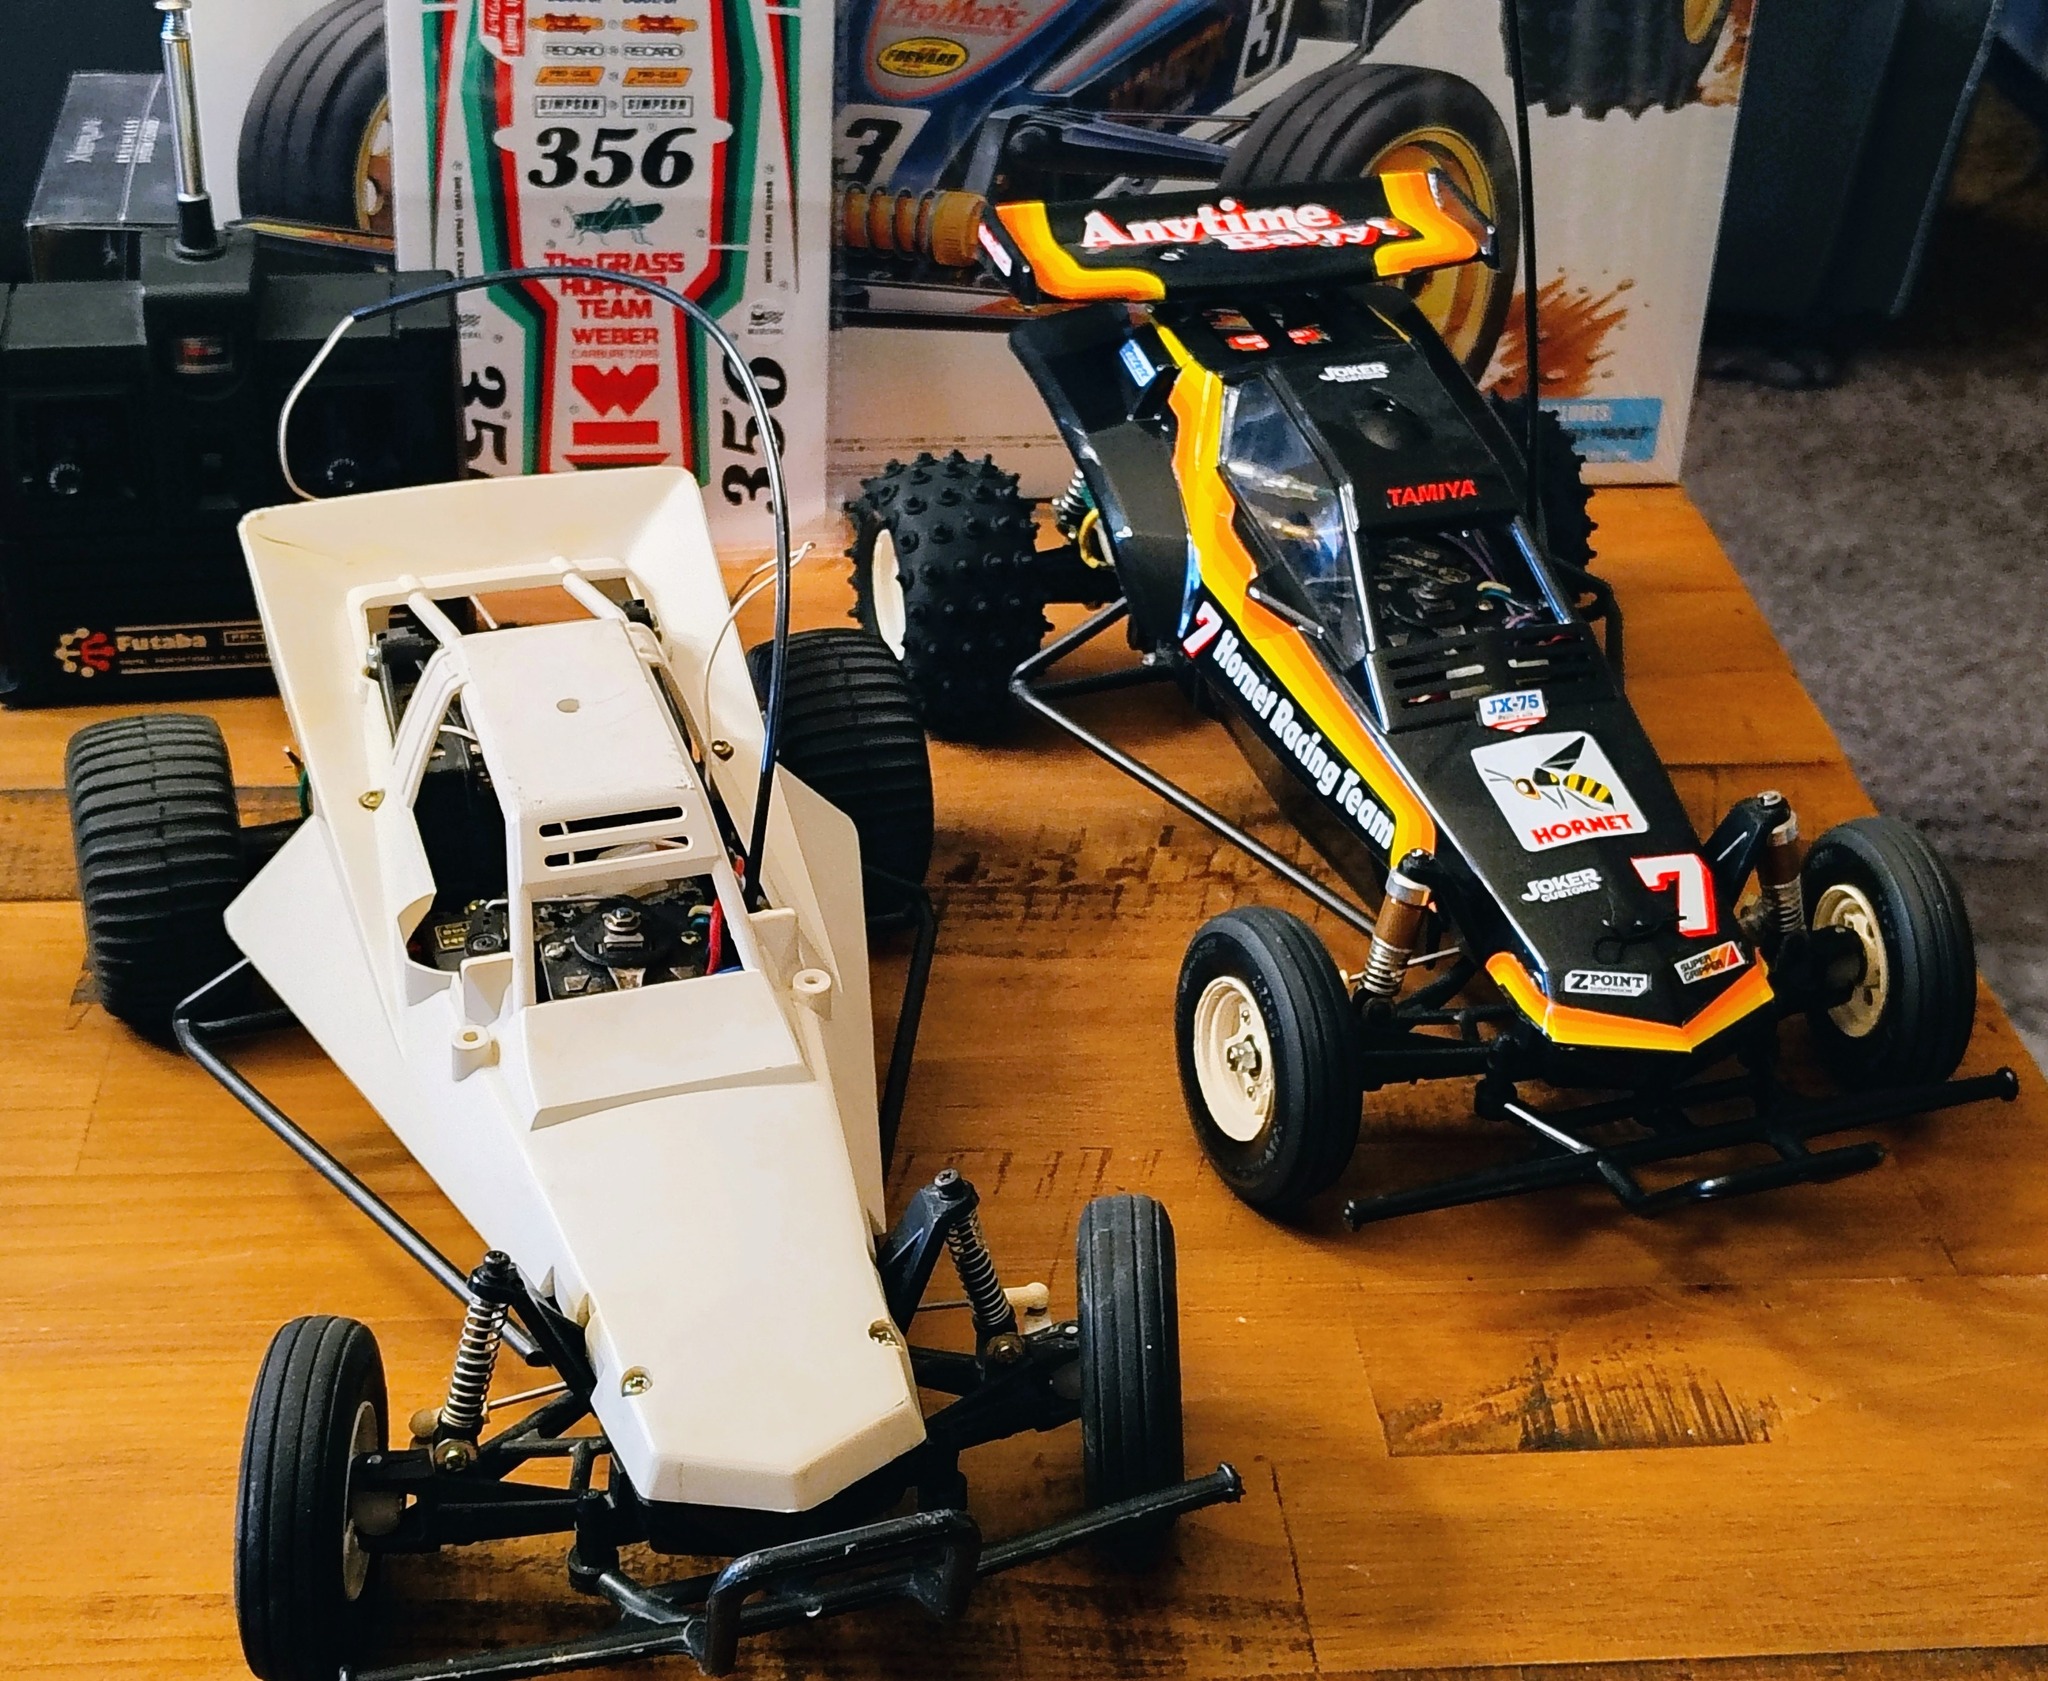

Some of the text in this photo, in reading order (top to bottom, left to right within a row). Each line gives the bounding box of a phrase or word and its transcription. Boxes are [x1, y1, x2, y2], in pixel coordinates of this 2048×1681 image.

[545, 45, 604, 57] RECARO
[624, 46, 683, 58] RECARO
[527, 127, 697, 188] 356
[1081, 196, 1345, 248] Anytime
[544, 252, 686, 274] The GRASS
[577, 299, 653, 319] TEAM
[571, 327, 660, 345] WEBER
[1318, 361, 1390, 381] JOKER
[462, 366, 508, 478] 35
[1387, 478, 1477, 507] TAMIYA
[116, 633, 207, 652] Futaba
[1487, 693, 1539, 715] JX-75
[1182, 600, 1395, 850] 7 Hornet Racing Team
[1531, 814, 1634, 845] HORNET
[1521, 868, 1602, 902] JOKER
[1541, 882, 1600, 903] CUSTOMS
[1630, 853, 1718, 938] 7
[1680, 954, 1712, 973] SUPER
[1684, 959, 1724, 982] GRIPPER
[1571, 973, 1644, 990] Z POINT
